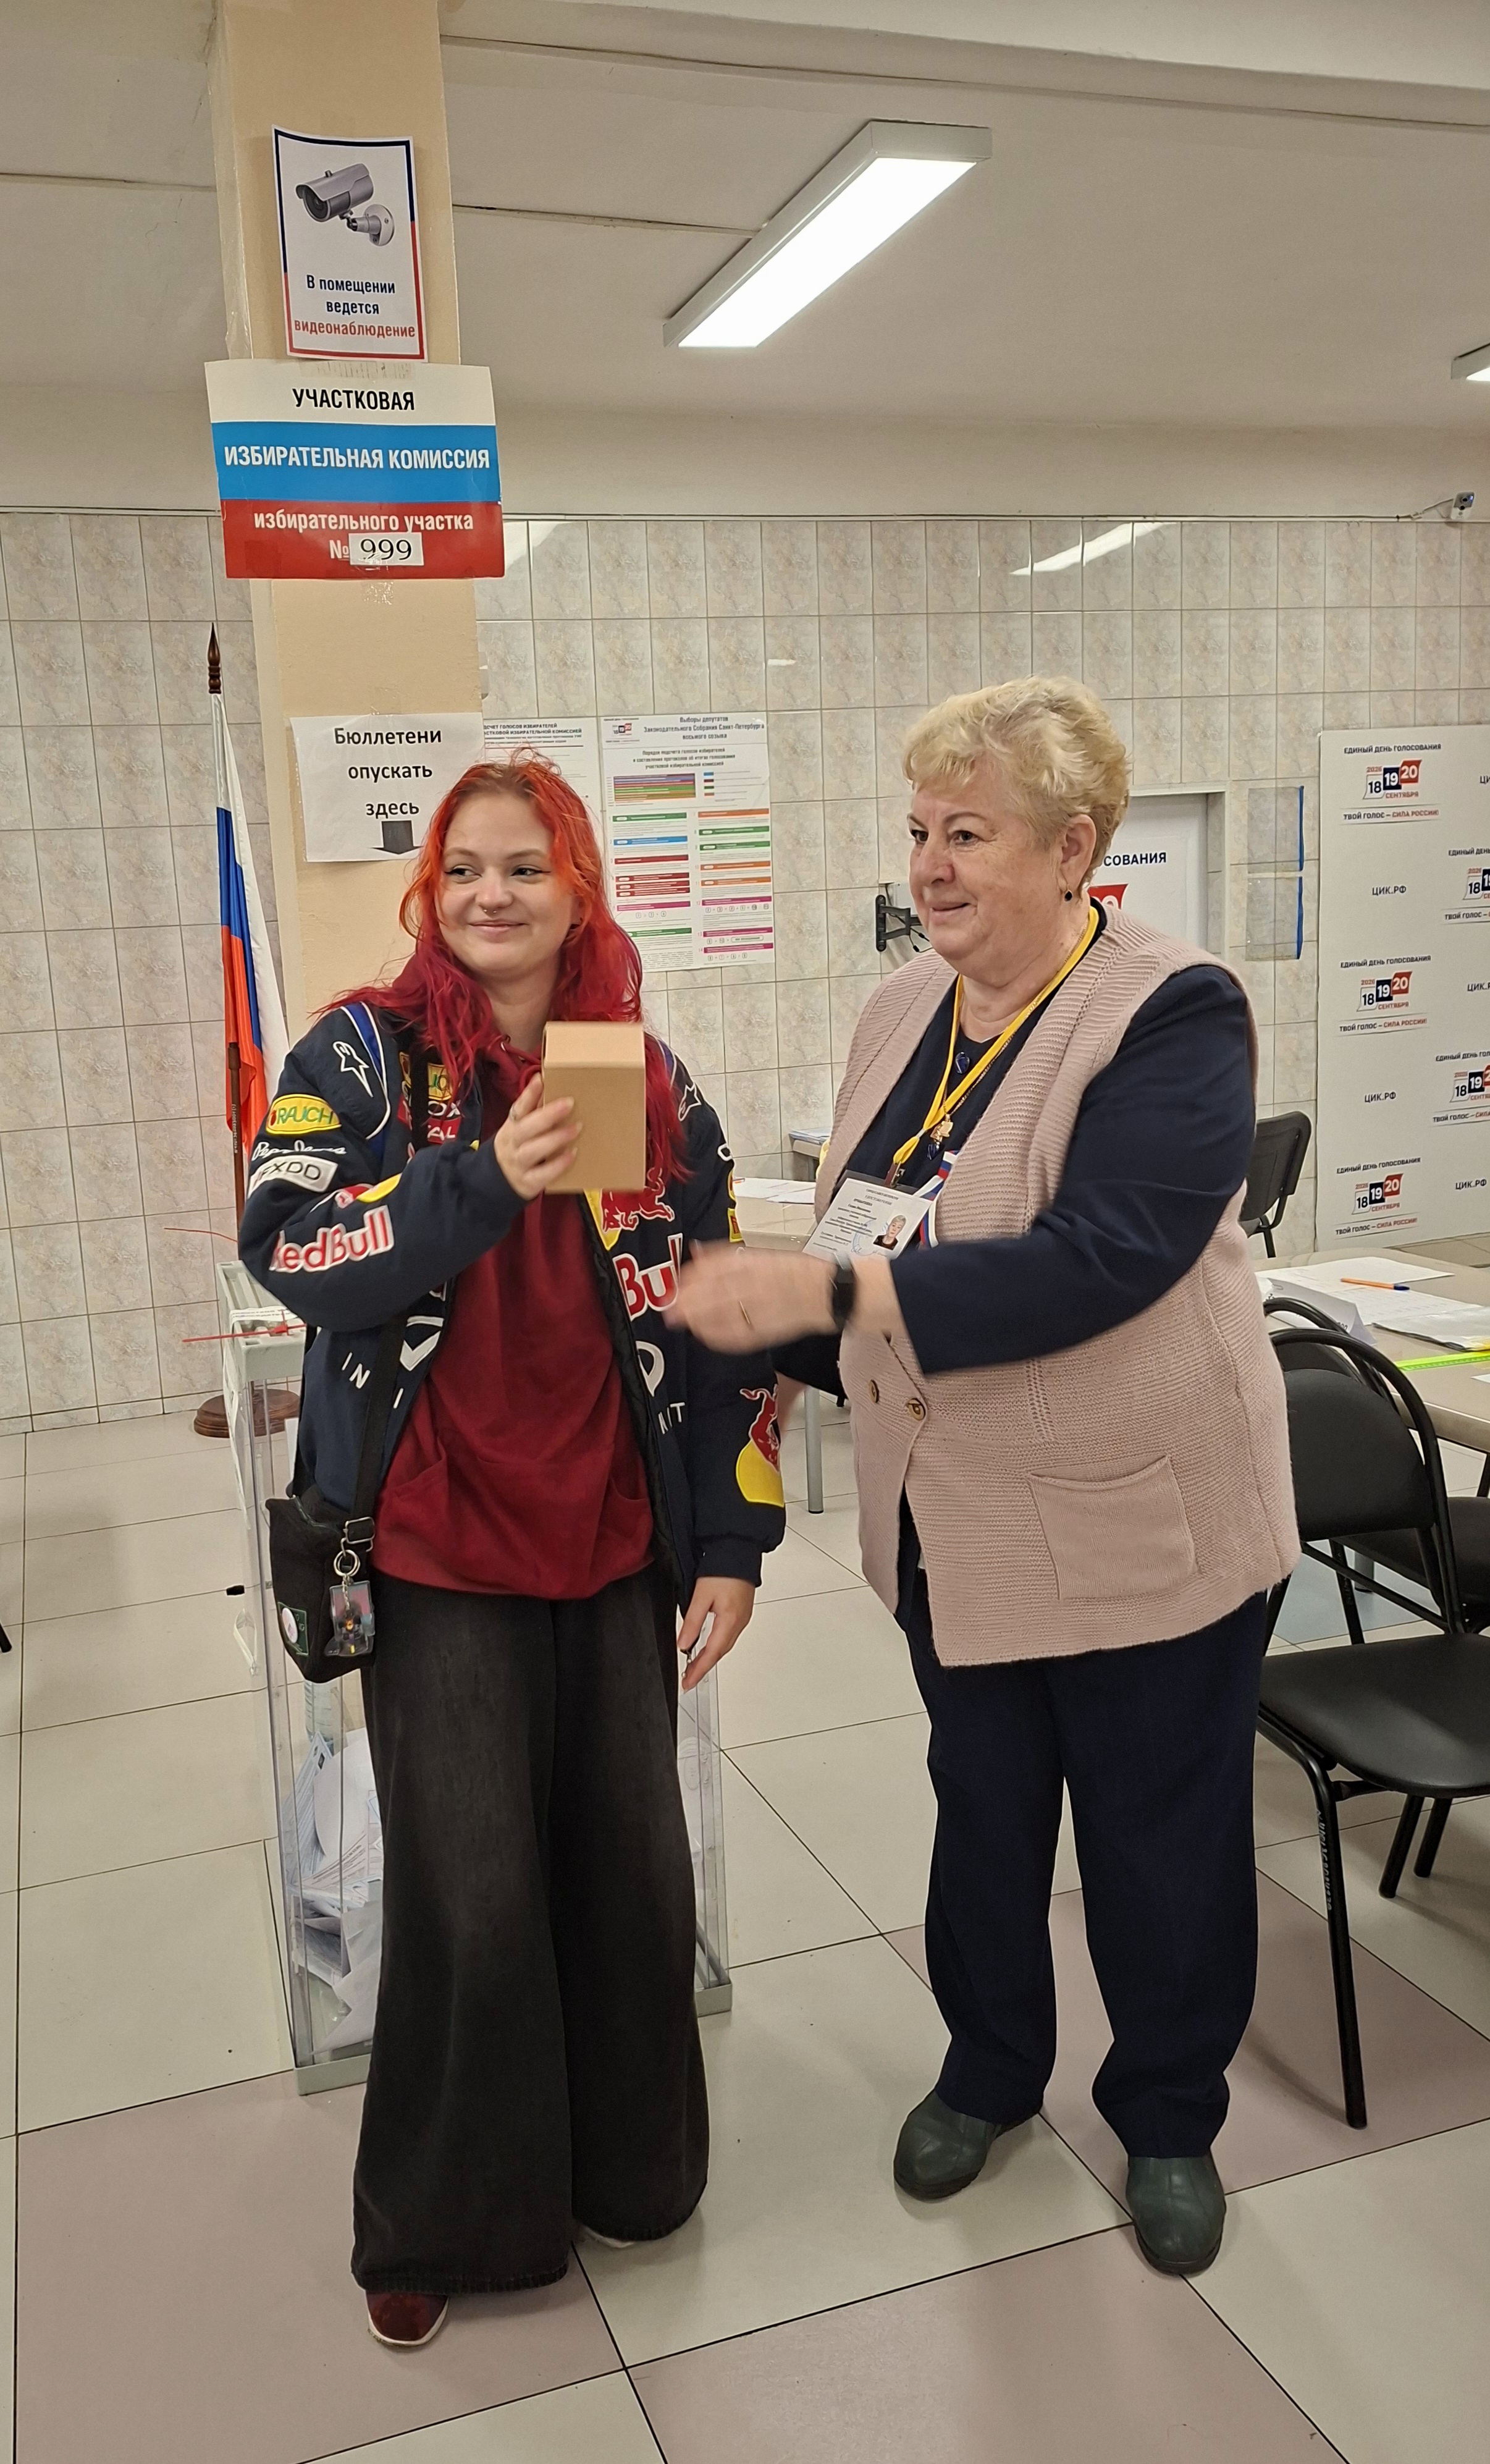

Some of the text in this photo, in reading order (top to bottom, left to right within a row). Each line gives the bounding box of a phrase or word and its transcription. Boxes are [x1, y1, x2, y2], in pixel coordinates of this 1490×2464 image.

[306, 275, 395, 295] В помещении
[326, 299, 380, 316] ведется
[294, 319, 415, 339] видеонаблюдение
[293, 388, 415, 412] УЧАСТКОВАЯ
[224, 446, 490, 471] ИЗБИРАТЕЛЬНАЯ КОМИССИЯ
[254, 511, 474, 533] избирательного участка
[329, 539, 413, 562] № 999
[334, 727, 442, 745] Бюллетени
[1344, 745, 1373, 754] ЕДИНЫЙ
[1394, 744, 1441, 752] ГОЛОСОВАНИЯ
[348, 765, 432, 783] опускать
[1368, 765, 1418, 794] 18 19 20
[365, 802, 419, 819] здесь
[1343, 812, 1362, 820] ТВОЙ
[1449, 847, 1475, 856] ЕДИНЫЙ
[1372, 885, 1407, 895] ЦИК.РФ
[1468, 882, 1480, 894] 18
[1445, 911, 1461, 919] ТВОЙ
[1341, 959, 1367, 968] ЕДИНЫЙ
[1386, 955, 1431, 964] ГОЛОСОВАНИЯ
[1362, 976, 1408, 1006] 18 19 20
[1378, 1002, 1409, 1010] СЕНТЯБРЯ
[1339, 1024, 1356, 1032] ТВОЙ
[1436, 1052, 1461, 1061] ЕДИНЫЙ
[1455, 1085, 1467, 1097] 18
[1470, 1076, 1482, 1089] 19
[1365, 1092, 1396, 1102] ЦИК.РФ
[277, 1106, 334, 1125] RAUCH
[1433, 1114, 1448, 1122] ТВОЙ
[1336, 1164, 1361, 1174] ЕДИНЫЙ
[1379, 1157, 1421, 1168] ГОЛОСОВАНИЯ
[1455, 1179, 1487, 1190] ЦИК.РФ
[1357, 1179, 1399, 1209] 18 19 20
[1371, 1202, 1400, 1212] СЕНТЯБРЯ
[1336, 1226, 1351, 1234] ТВОЙ
[1352, 1225, 1370, 1233] ГОЛОС
